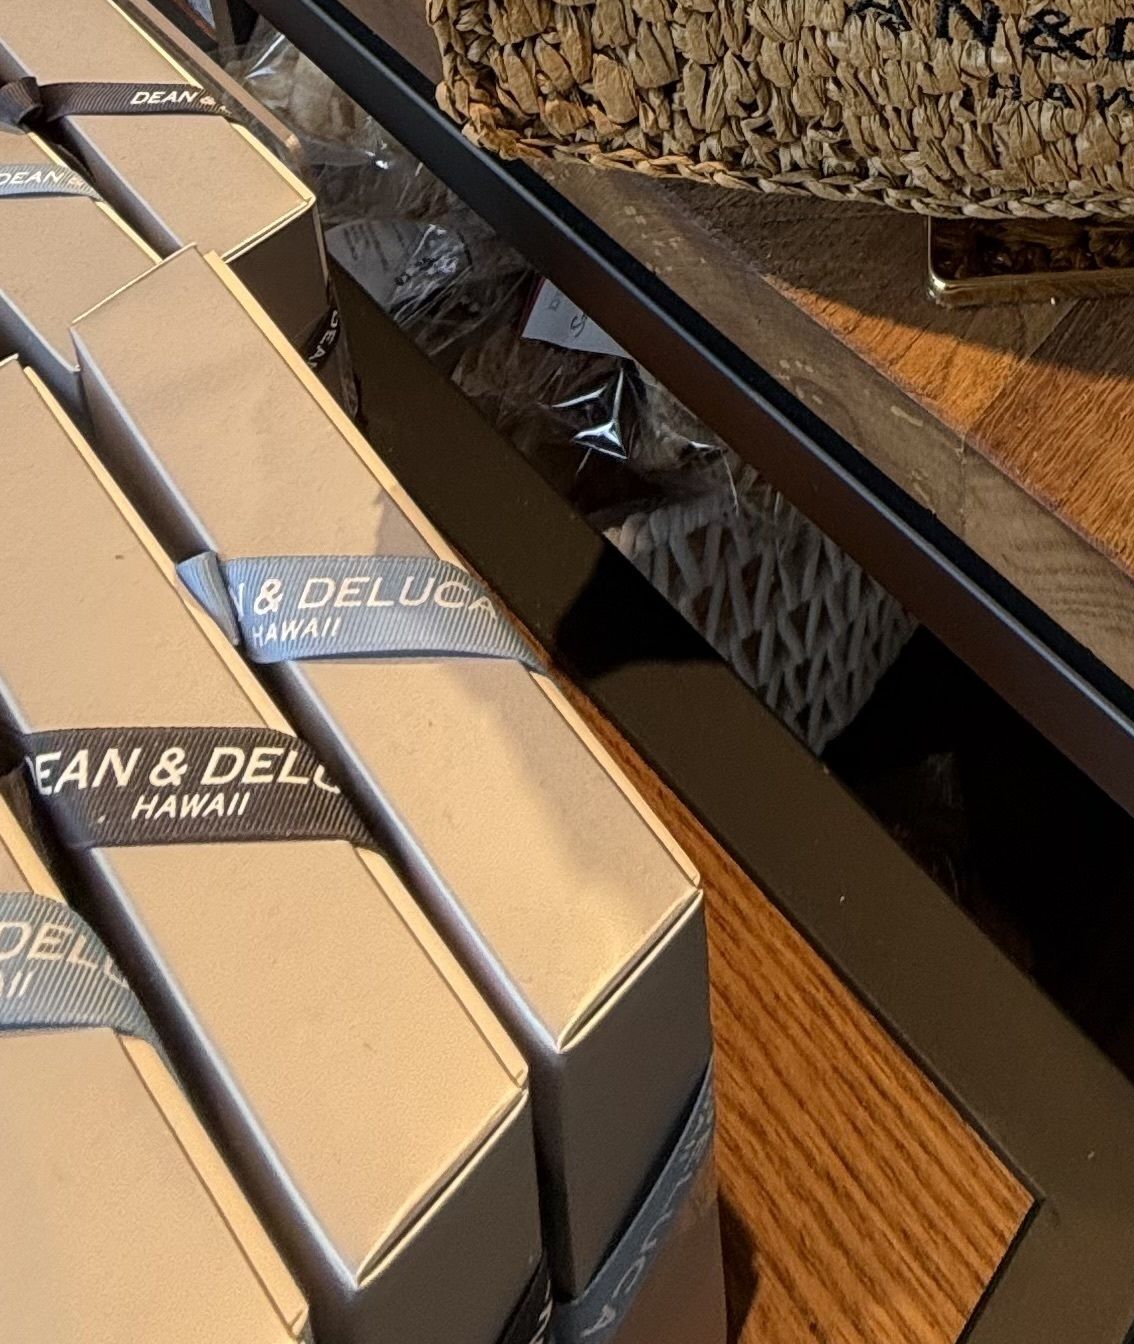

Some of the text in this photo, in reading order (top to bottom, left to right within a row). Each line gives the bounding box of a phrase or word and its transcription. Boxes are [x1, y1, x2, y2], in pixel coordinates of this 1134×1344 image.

[130, 91, 199, 105] DEAN
[0, 171, 65, 185] DEAN
[253, 578, 284, 616] &
[297, 576, 497, 620] DELUCA
[252, 617, 341, 647] HAWAII
[25, 747, 341, 795] EAN & DELU
[131, 792, 250, 820] HAWAII
